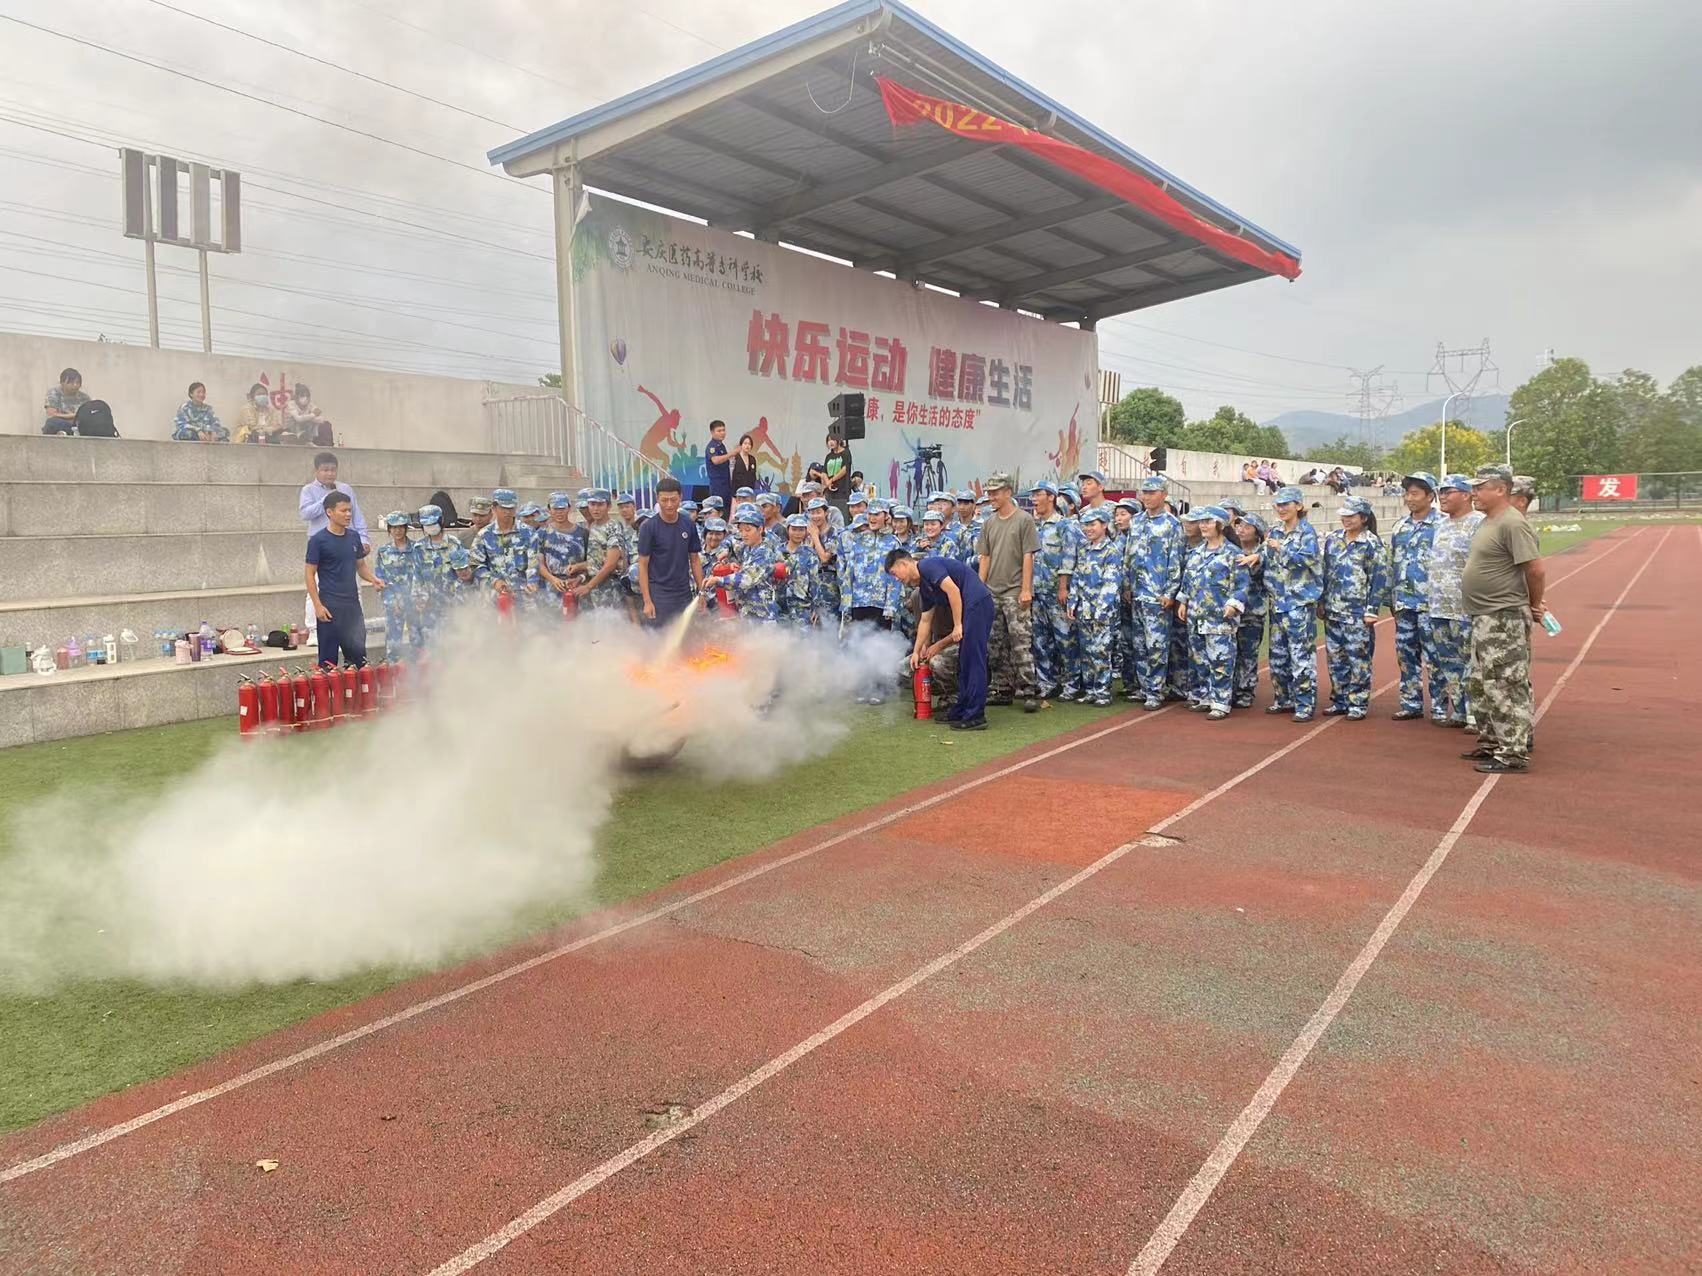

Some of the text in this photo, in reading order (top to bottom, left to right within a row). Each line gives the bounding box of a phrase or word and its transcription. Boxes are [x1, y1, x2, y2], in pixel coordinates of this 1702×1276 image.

[647, 264, 756, 296] ANQING MEDICAL COLLEGE
[746, 309, 1033, 412] 快乐运动 健康生活
[1598, 477, 1621, 497] 发
